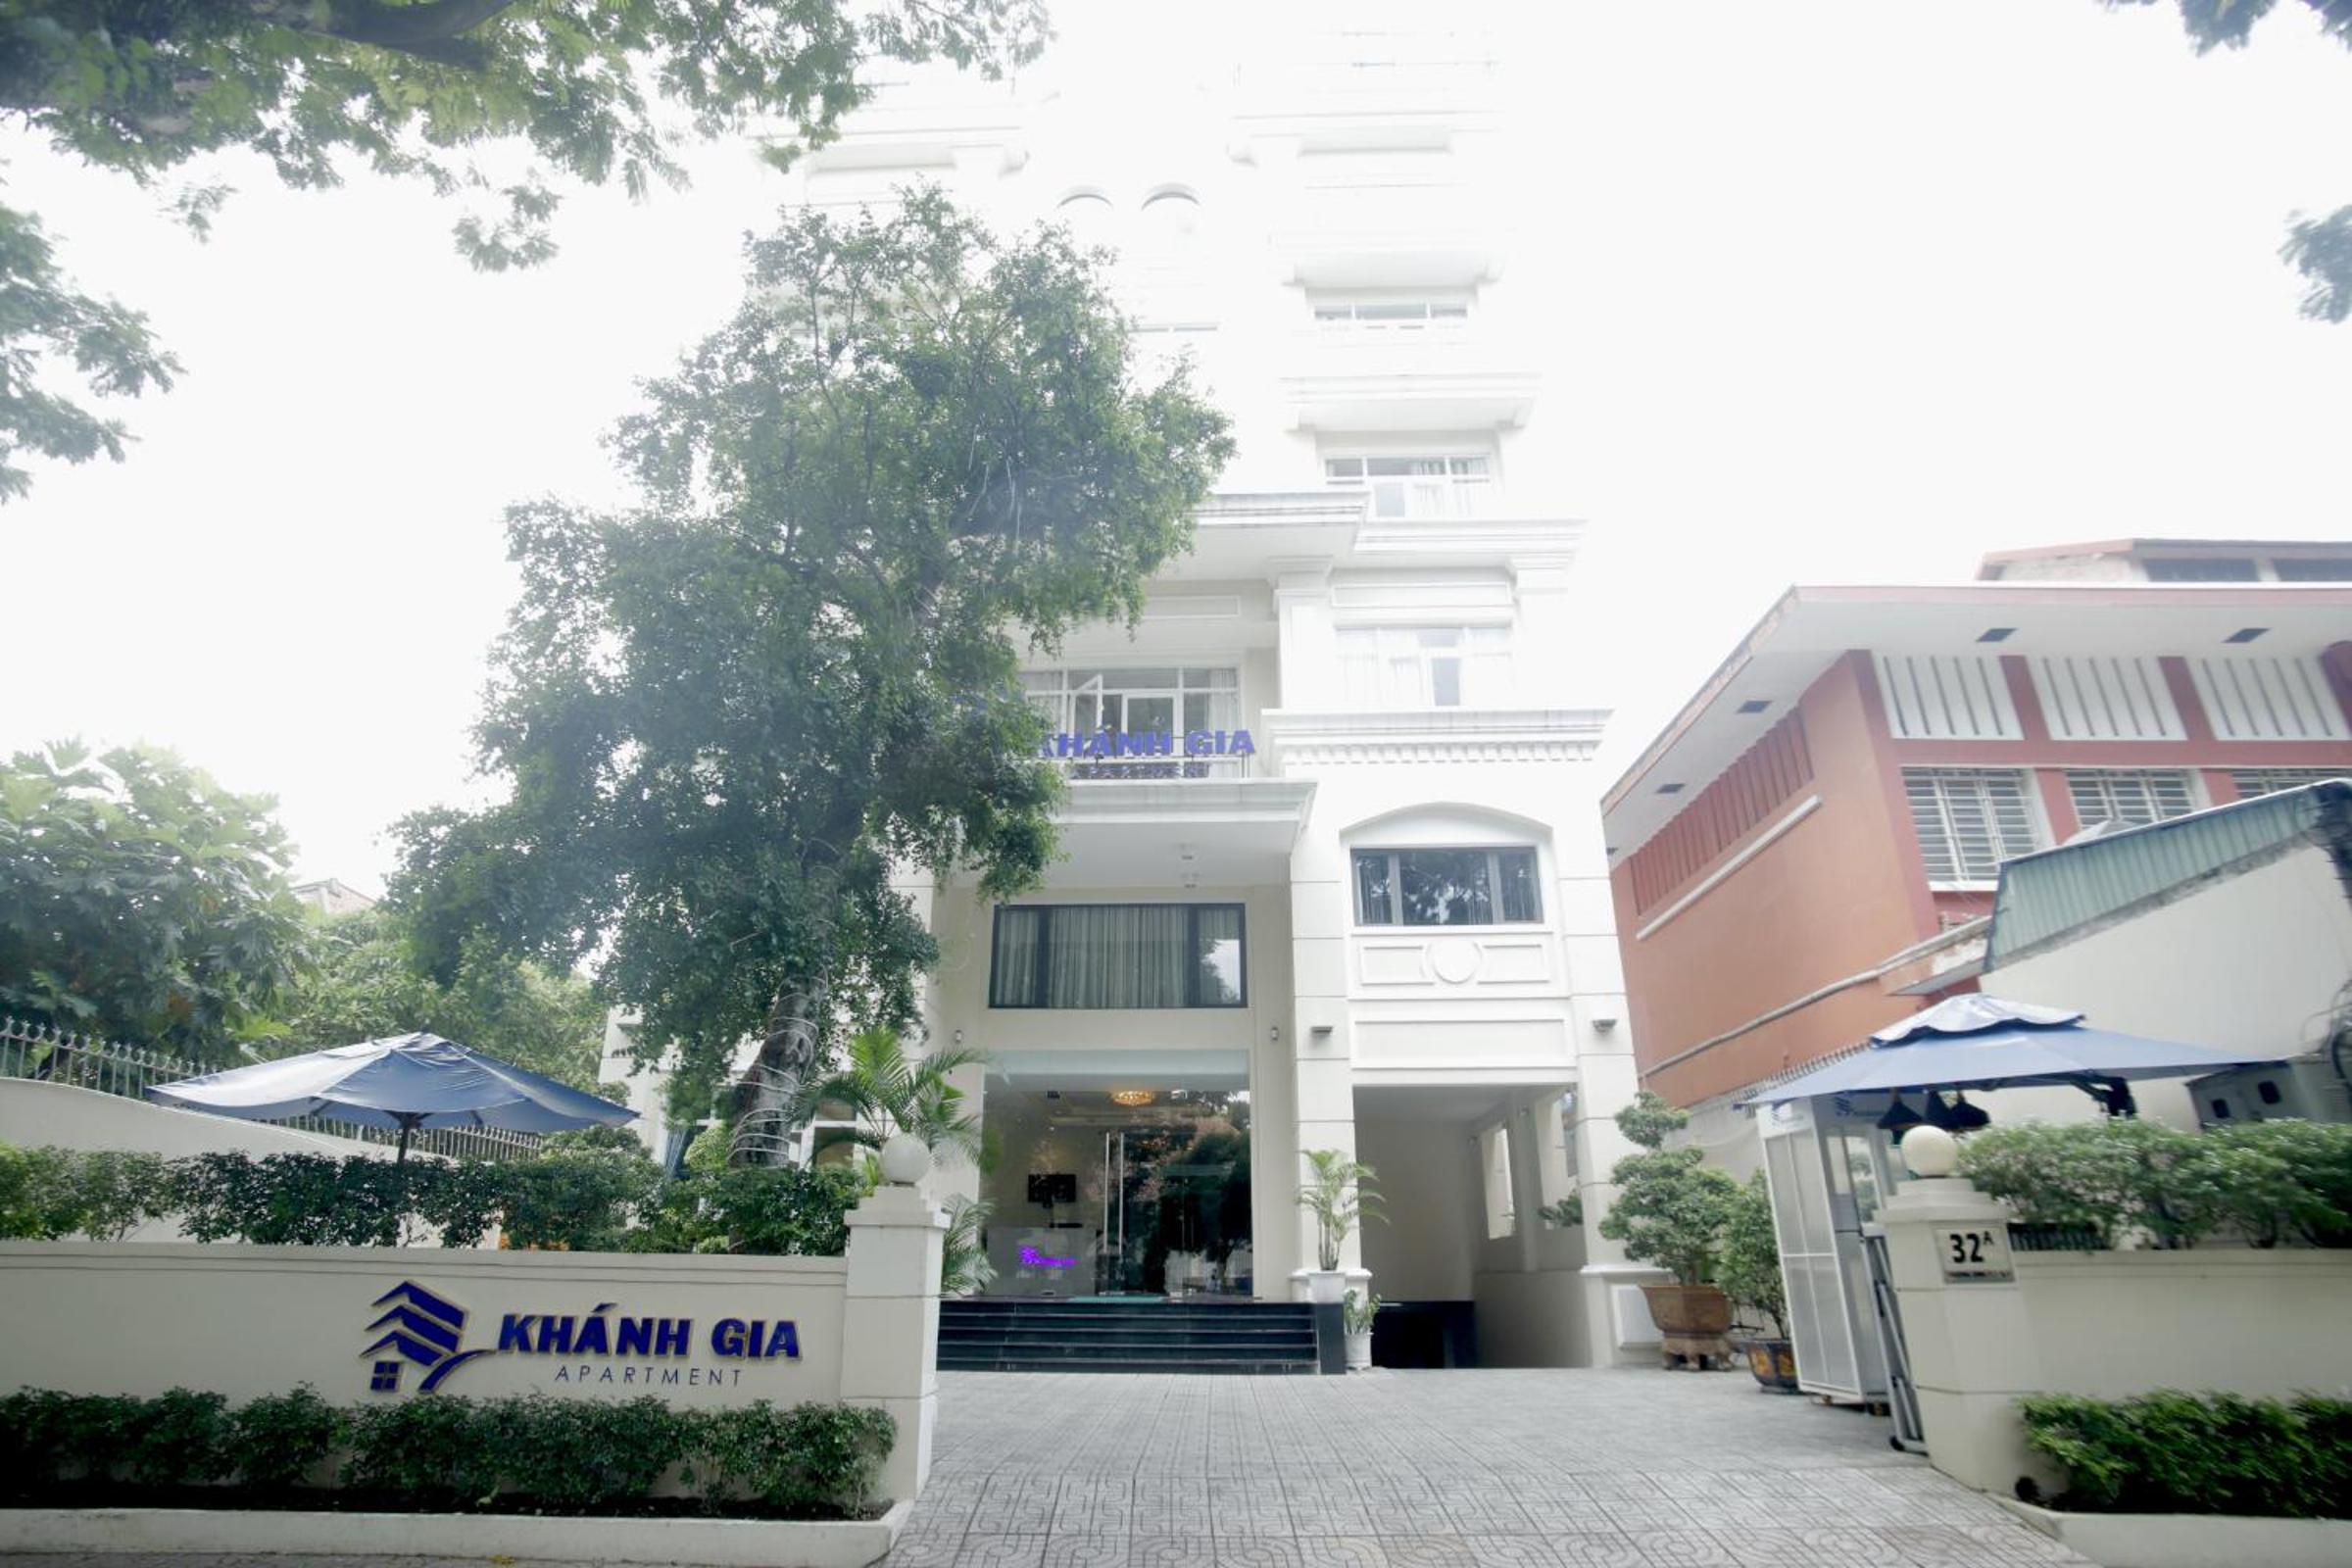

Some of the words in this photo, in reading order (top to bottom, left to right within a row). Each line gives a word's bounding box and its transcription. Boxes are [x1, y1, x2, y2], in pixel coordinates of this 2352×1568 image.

[1184, 729, 1256, 755] GIA
[1949, 1231, 1994, 1263] 32A
[498, 1302, 694, 1356] KHÁNH
[710, 1317, 803, 1360] GIA
[555, 1364, 743, 1387] APARTMENT
